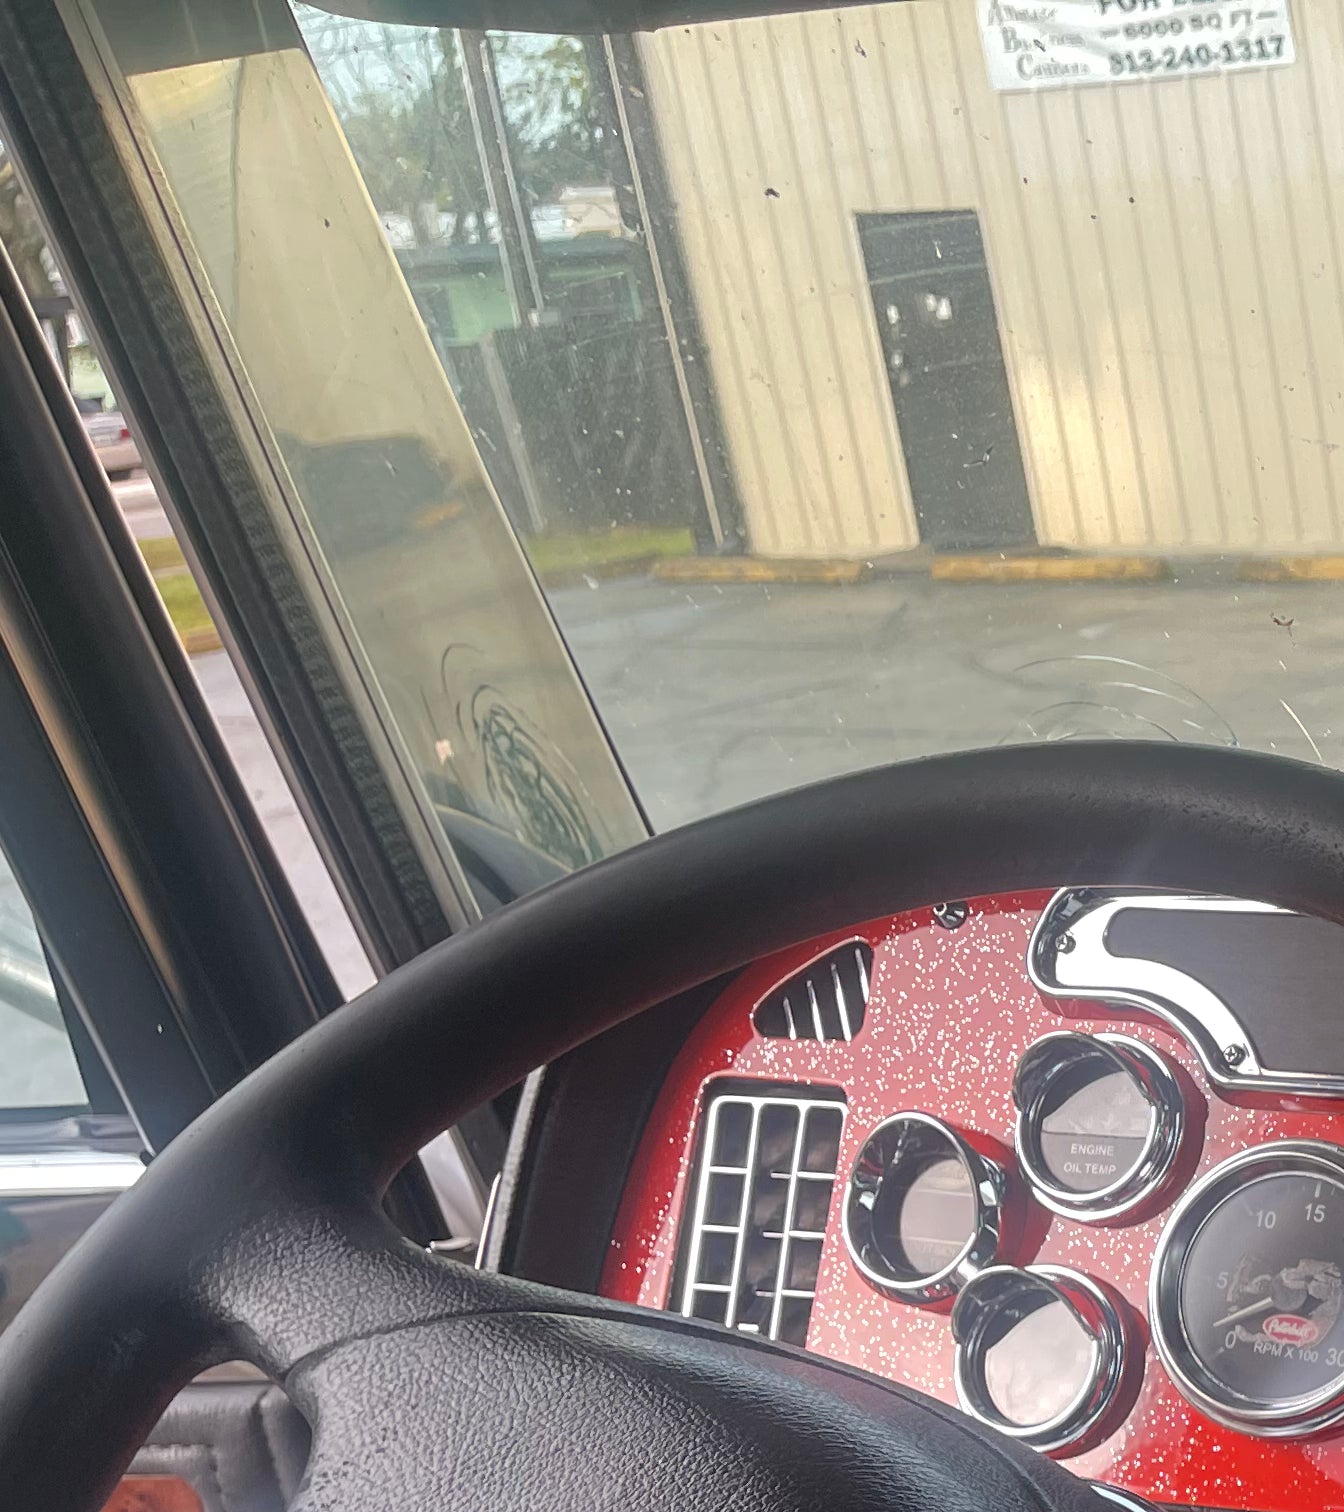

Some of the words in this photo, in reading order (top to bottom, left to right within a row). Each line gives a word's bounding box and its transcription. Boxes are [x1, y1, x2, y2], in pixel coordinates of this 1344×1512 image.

[1070, 1144, 1115, 1156] ENGINE
[1063, 1162, 1082, 1173] OIL
[1085, 1163, 1117, 1175] TEMP
[1255, 1211, 1276, 1229] 10
[1304, 1204, 1326, 1222] 15
[1254, 1342, 1282, 1357] RPM
[1284, 1347, 1294, 1359] X
[1299, 1350, 1318, 1362] 100
